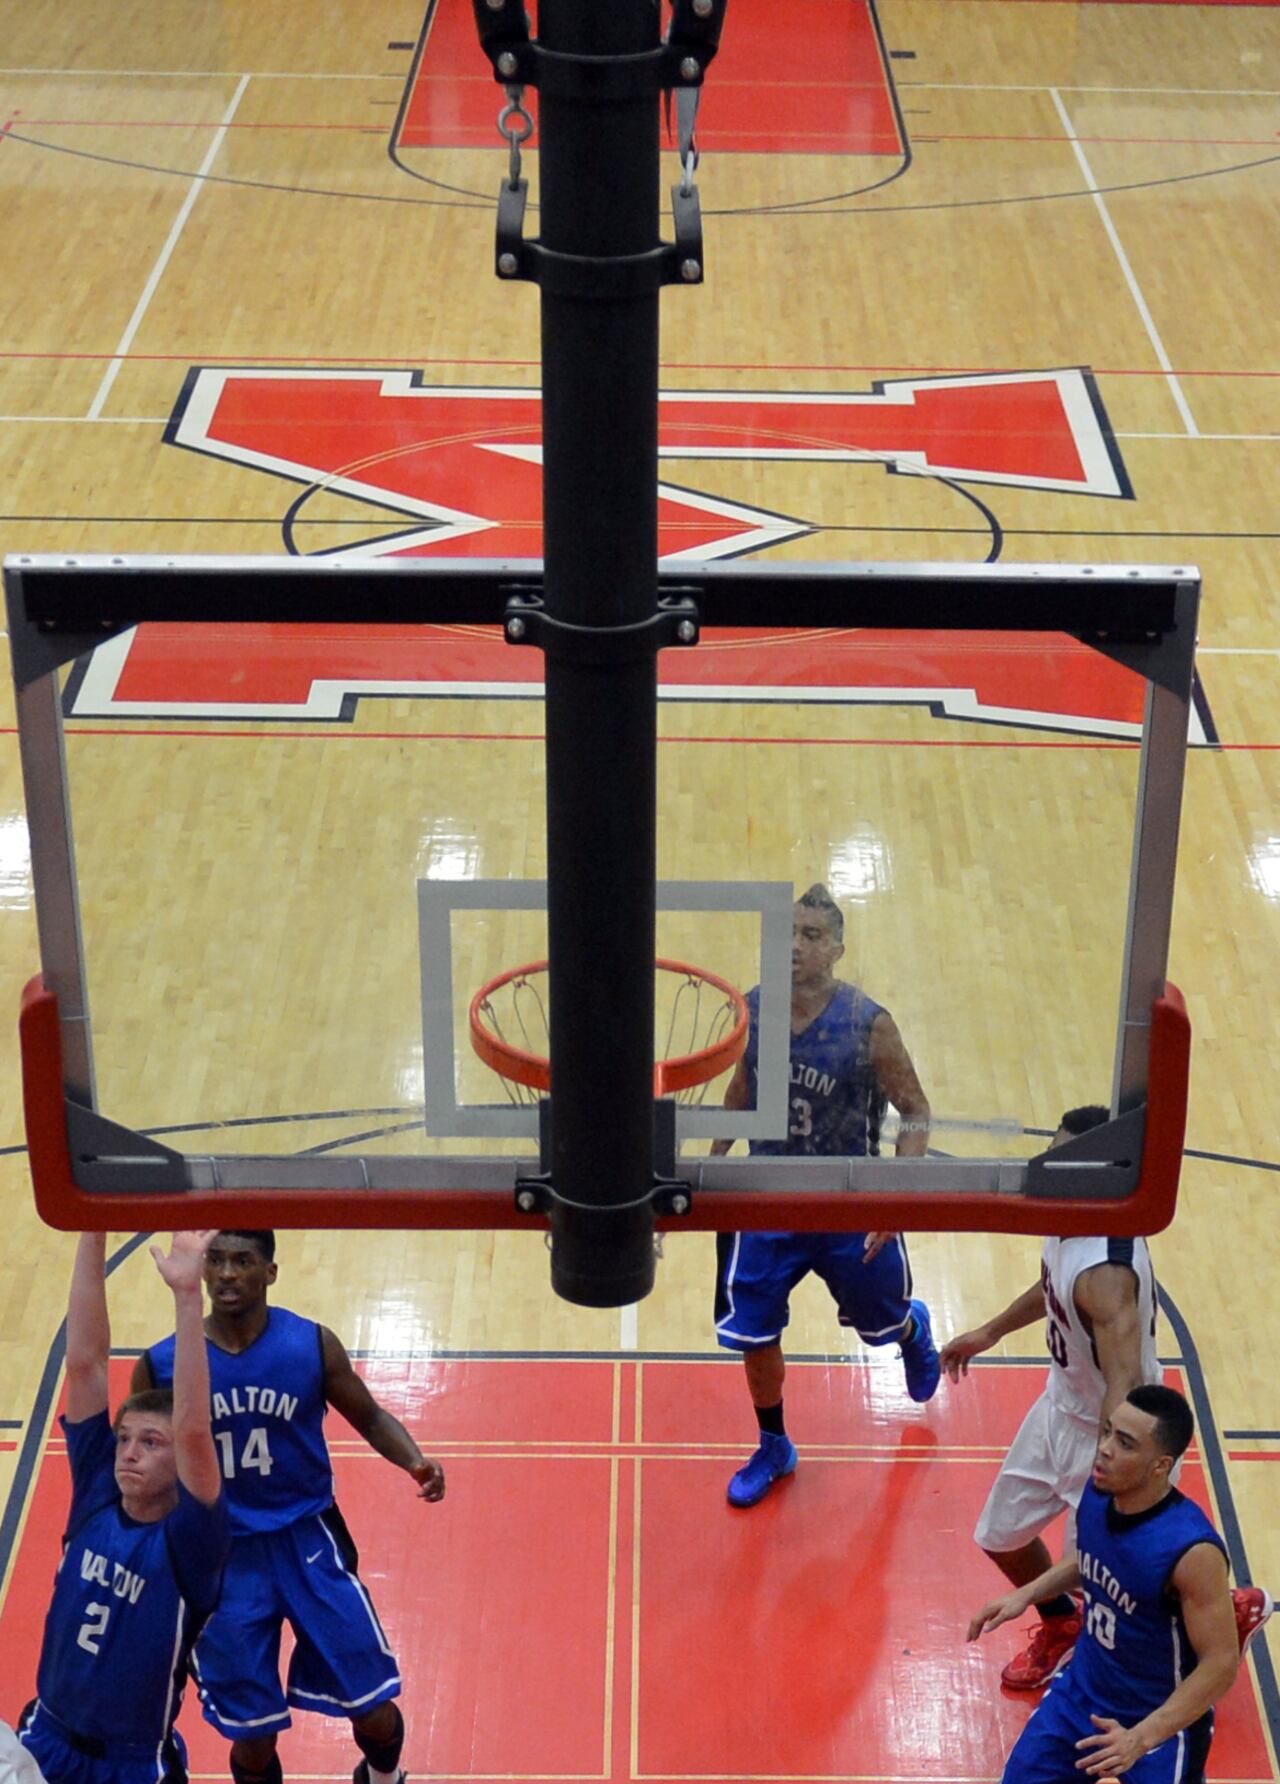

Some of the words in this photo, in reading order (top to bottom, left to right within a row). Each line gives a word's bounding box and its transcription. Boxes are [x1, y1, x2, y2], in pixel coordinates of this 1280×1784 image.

[211, 1386, 298, 1421] ALTON
[215, 1427, 273, 1479] 14
[77, 1601, 110, 1655] 2
